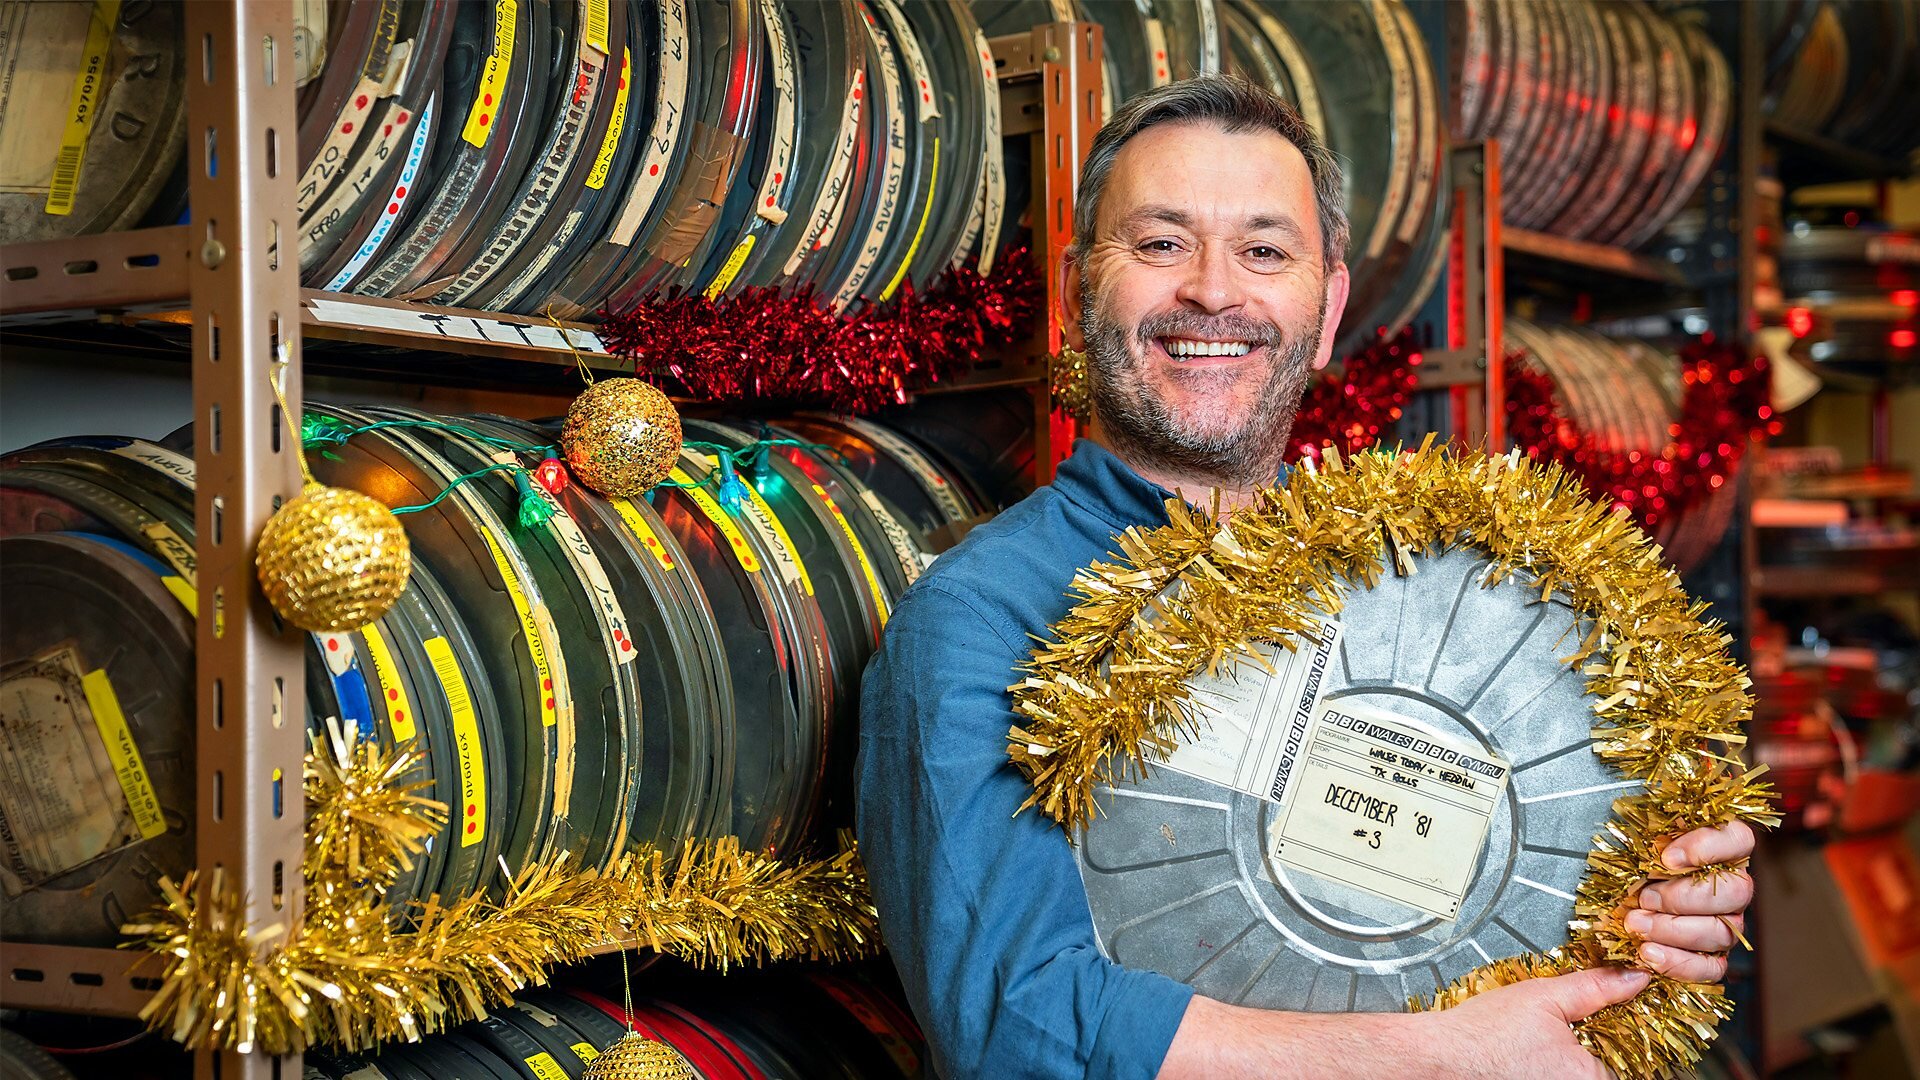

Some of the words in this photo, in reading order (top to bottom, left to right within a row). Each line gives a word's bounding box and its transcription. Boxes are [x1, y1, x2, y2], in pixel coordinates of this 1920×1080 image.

[75, 55, 100, 124] X970956
[593, 102, 624, 185] X970933
[353, 219, 391, 262] TODAY
[402, 110, 429, 183] CARDIFF
[798, 209, 830, 260] MARCH
[840, 245, 878, 302] ROLLS
[876, 162, 902, 233] AUGUST
[524, 609, 548, 677] X970958
[1298, 666, 1324, 714] WALES
[1284, 712, 1309, 757] BBC
[1314, 744, 1330, 754] STORY
[1319, 729, 1350, 743] PROGRAMME
[1322, 709, 1369, 733] BBC
[1365, 725, 1414, 749] WALES
[1411, 739, 1459, 764] BBC
[1456, 755, 1506, 780] CYMRU
[1369, 747, 1398, 763] WALES
[1400, 756, 1427, 773] TODAY
[118, 728, 161, 824] X970957
[459, 732, 474, 798] X970940
[1270, 753, 1295, 803] CYMRU
[1308, 759, 1329, 770] DETAILS
[1370, 765, 1387, 779] TX
[1392, 774, 1420, 788] ROLLS
[1324, 783, 1398, 827] DECEMBER
[1413, 811, 1433, 838] '81
